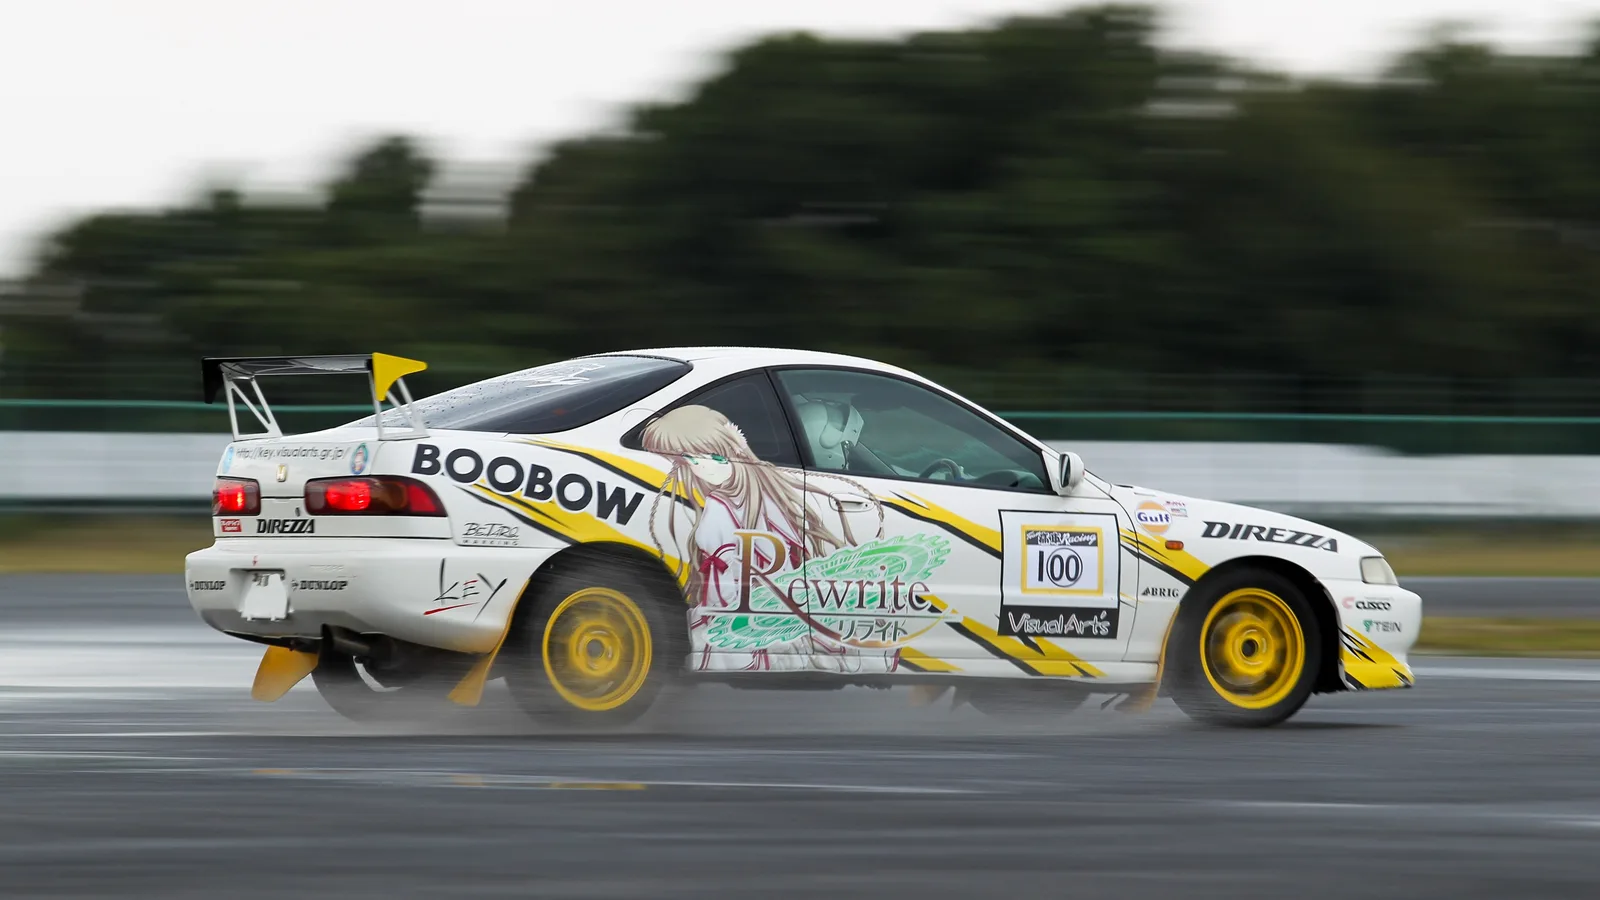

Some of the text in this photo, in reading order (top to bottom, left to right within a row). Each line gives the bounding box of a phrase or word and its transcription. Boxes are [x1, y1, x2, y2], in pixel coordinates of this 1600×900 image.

[411, 444, 645, 526] BOOBOW
[1137, 511, 1170, 522] Gulf
[257, 519, 315, 534] DIREZZA
[1061, 532, 1097, 546] Racing
[1201, 521, 1338, 553] DIREZZA
[733, 531, 931, 616] Rewrite
[1038, 550, 1080, 582] 100
[194, 580, 226, 590] DUNLOP
[300, 580, 348, 590] DUNLOP
[838, 619, 908, 643] リライト
[1372, 620, 1402, 633] TEIN
